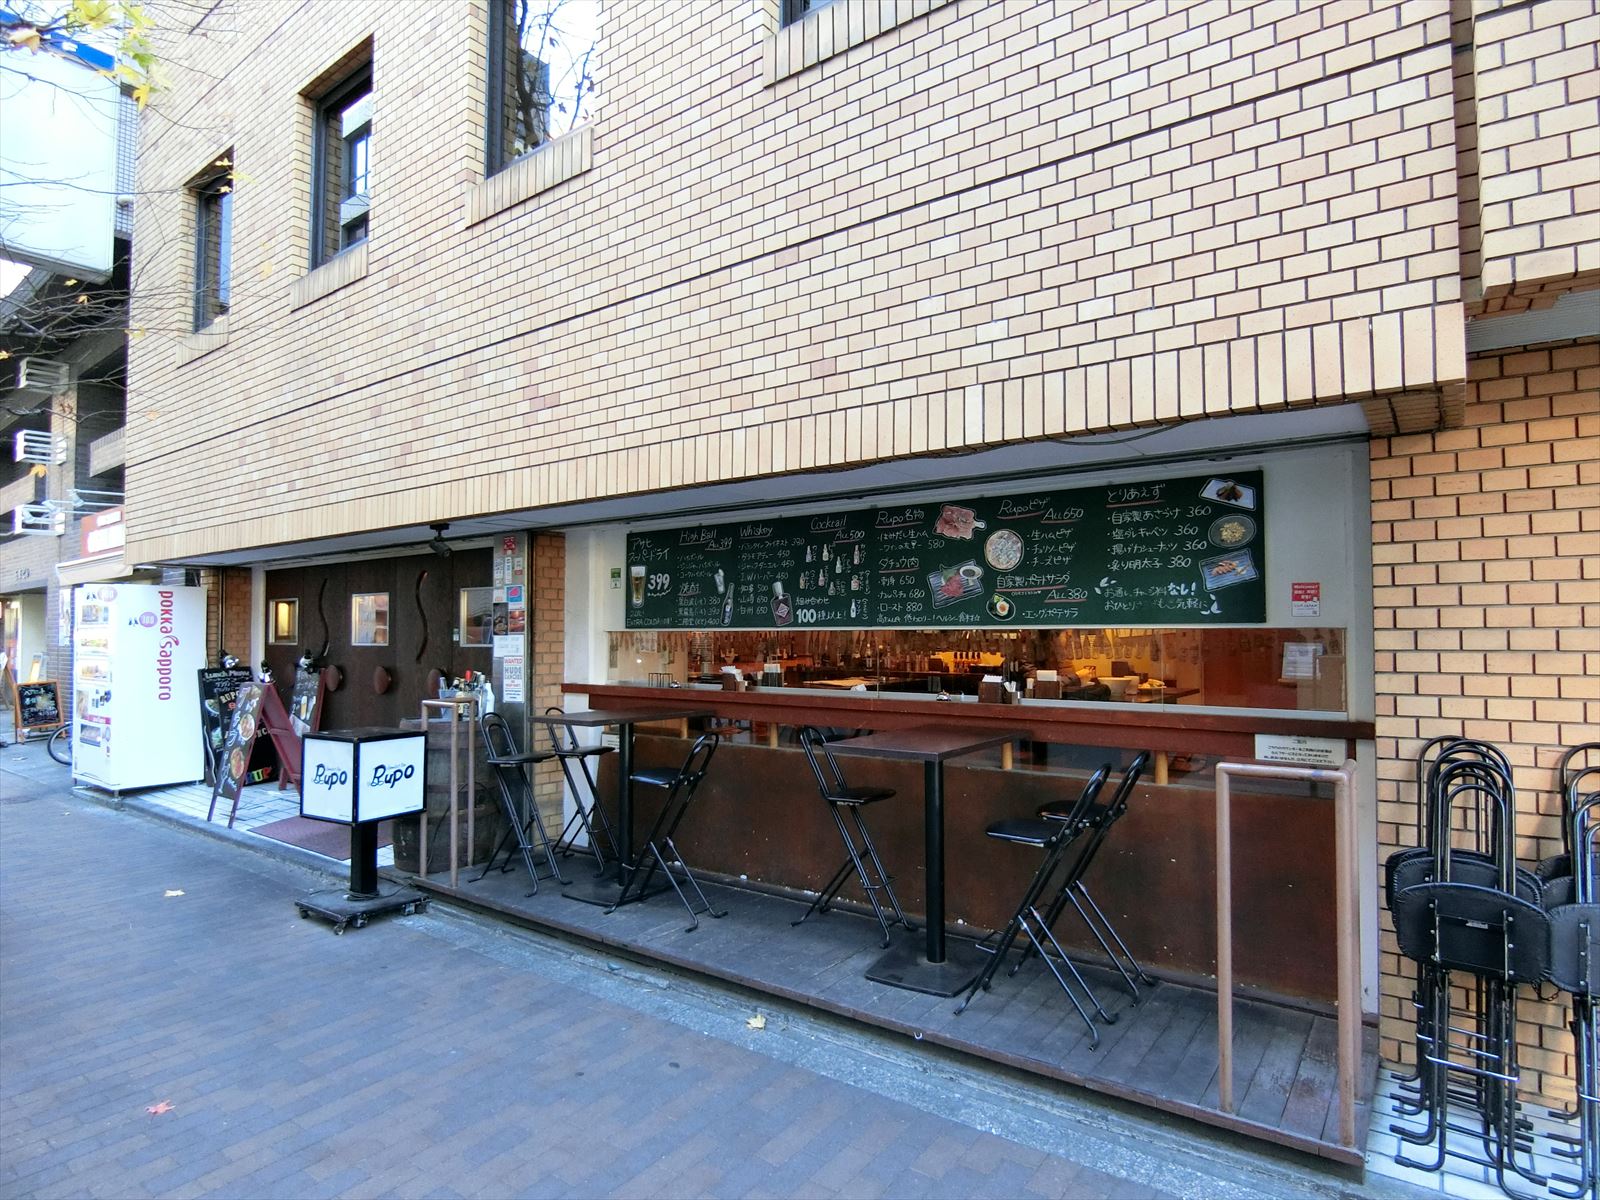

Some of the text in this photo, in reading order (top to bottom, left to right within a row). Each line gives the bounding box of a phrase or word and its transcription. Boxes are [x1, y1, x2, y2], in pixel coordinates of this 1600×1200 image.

[1107, 483, 1166, 502] とりあえず
[1186, 505, 1212, 519] 360
[811, 514, 848, 530] Cocktail
[1174, 524, 1199, 536] 360
[928, 540, 945, 549] 580
[1183, 540, 1207, 551] 360
[1168, 556, 1192, 568] 380
[647, 573, 671, 591] 399
[900, 576, 916, 585] 650
[908, 588, 925, 599] 680
[905, 602, 923, 612] 880
[371, 764, 415, 789] Rupo
